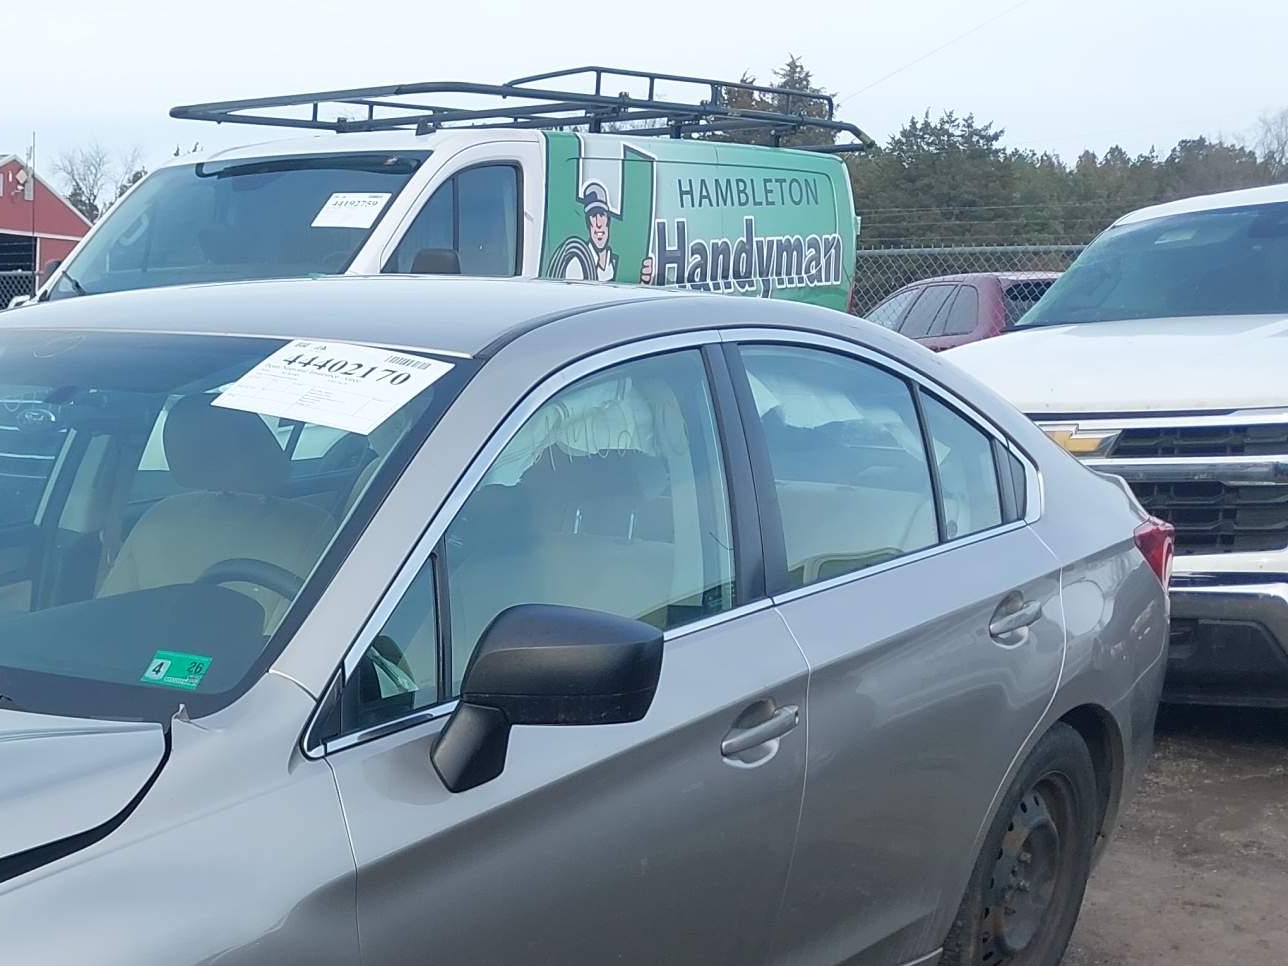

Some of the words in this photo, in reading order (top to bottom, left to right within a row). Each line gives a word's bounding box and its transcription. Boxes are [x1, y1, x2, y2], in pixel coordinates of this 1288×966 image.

[678, 177, 819, 209] HAMBLETON
[655, 216, 843, 299] Handyman
[283, 352, 411, 386] 44402170
[152, 661, 165, 675] 4
[187, 661, 205, 674] 26
